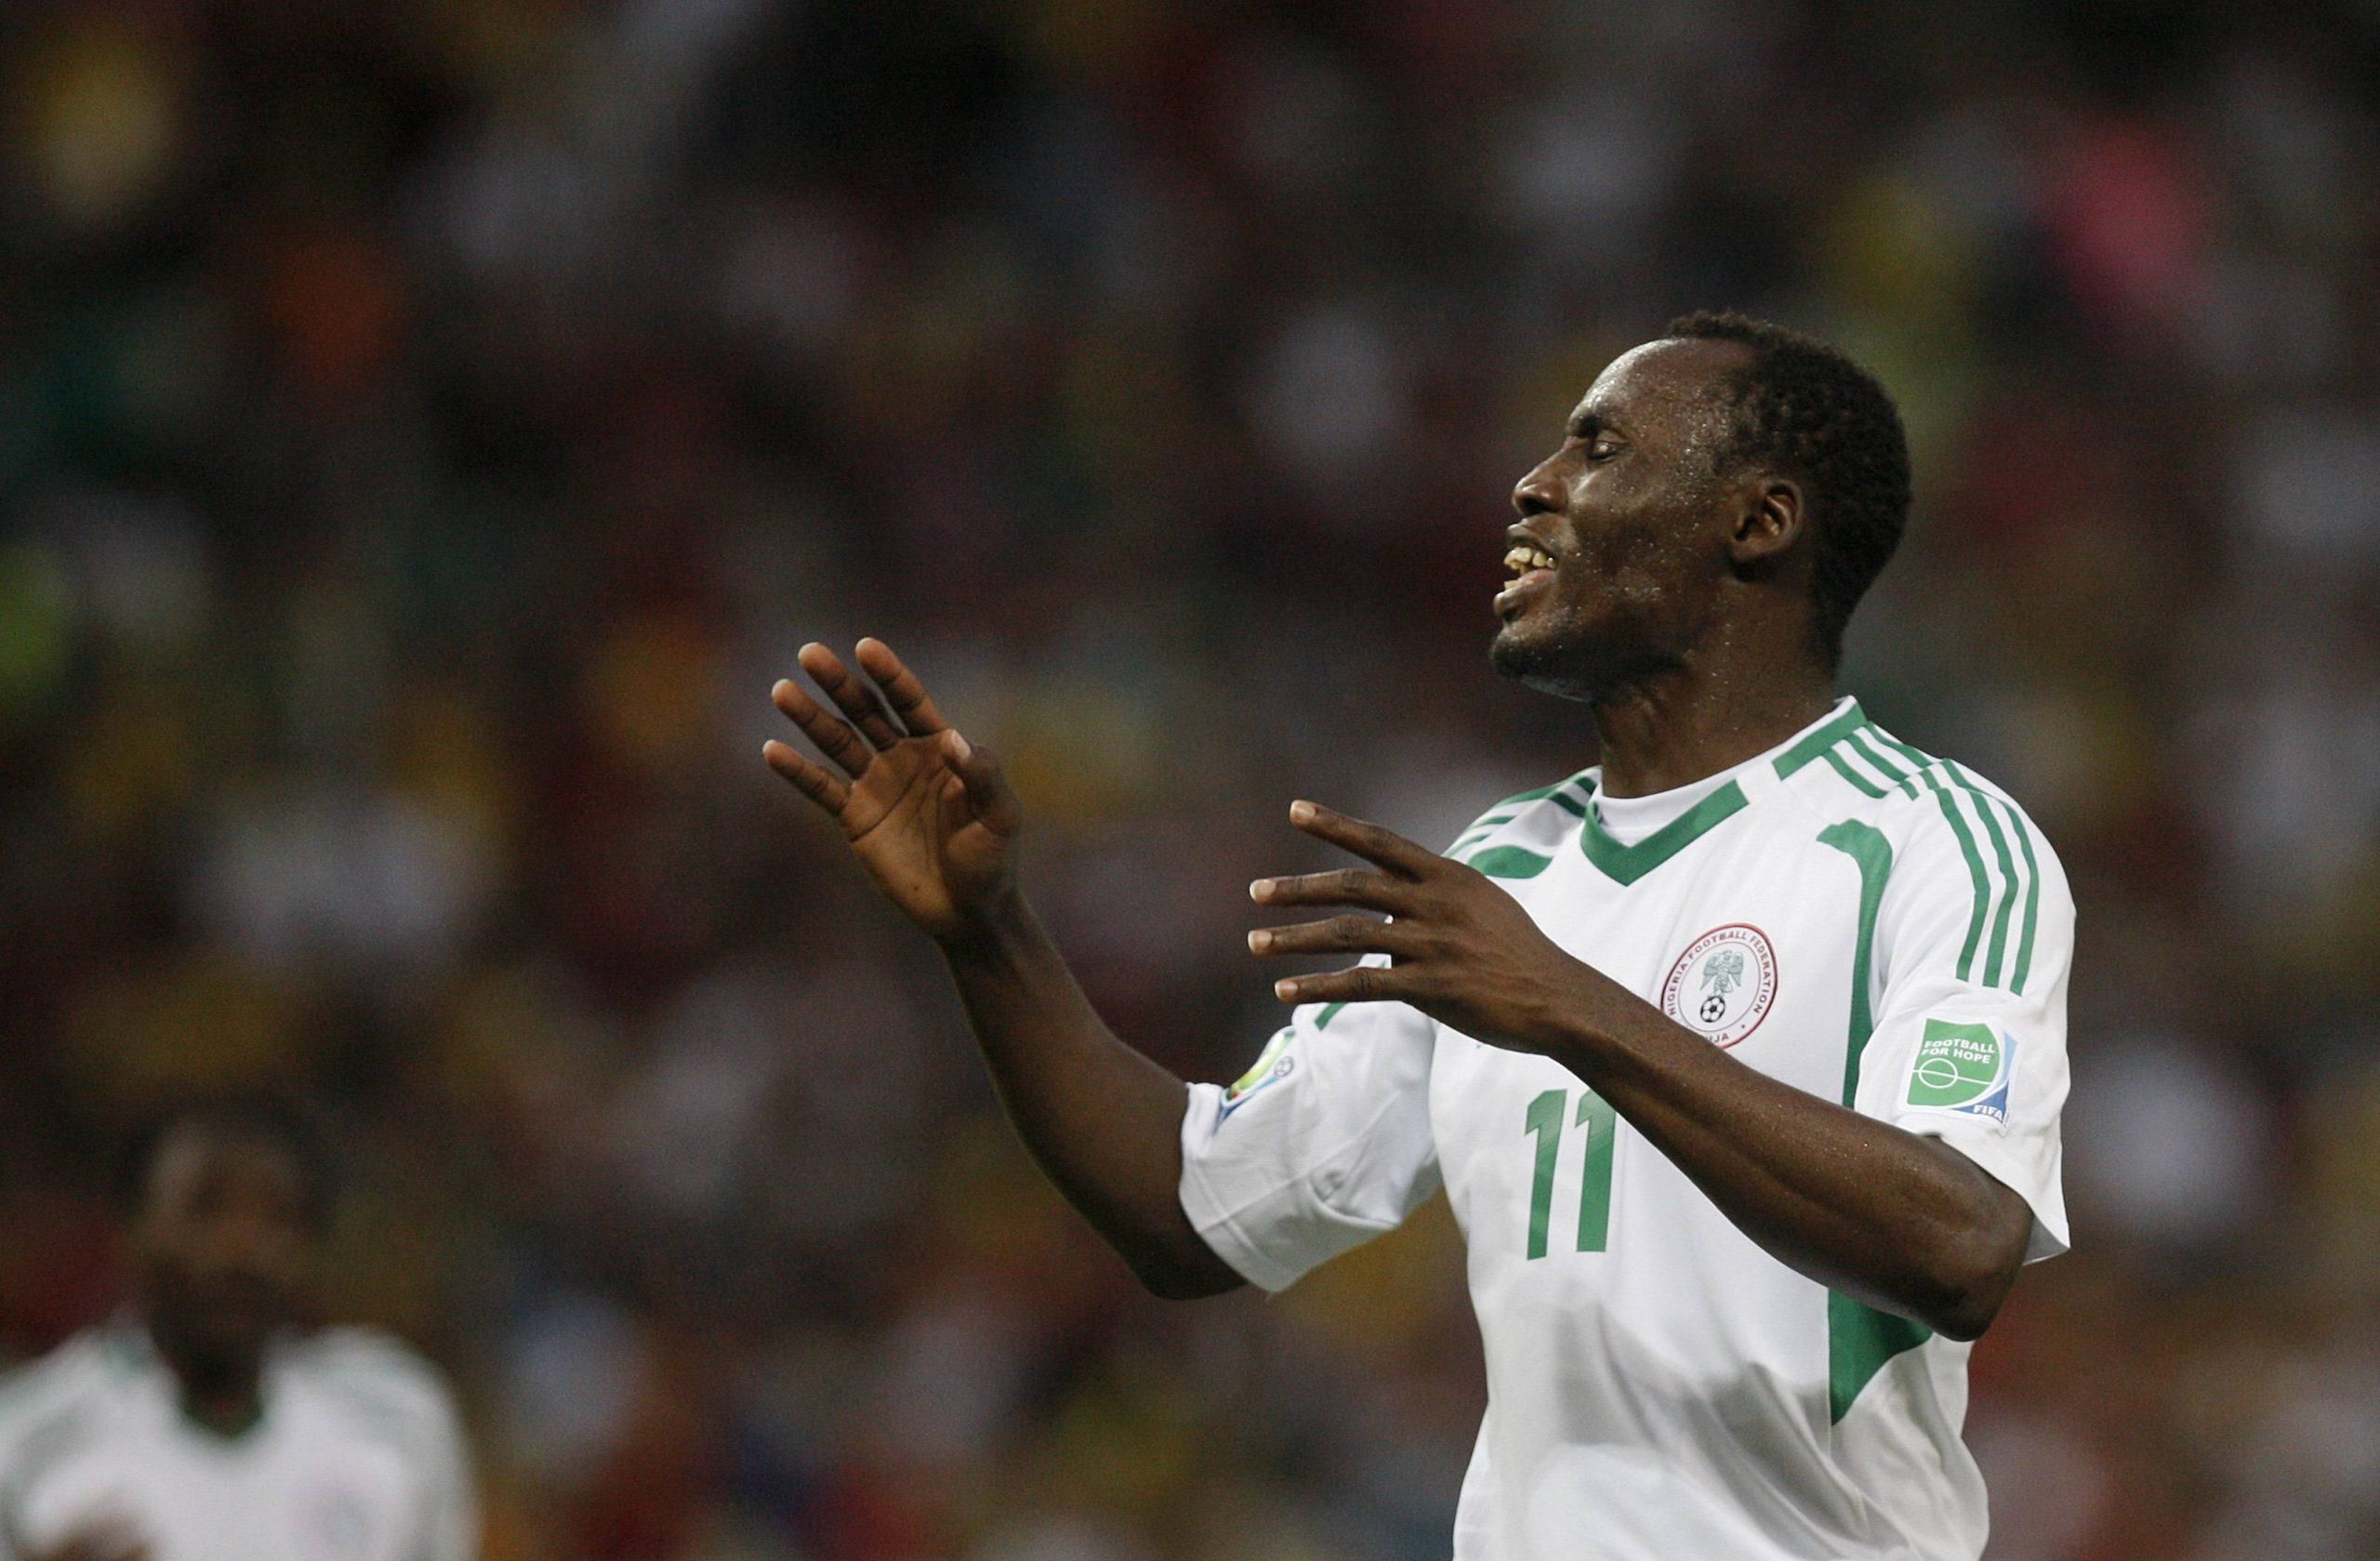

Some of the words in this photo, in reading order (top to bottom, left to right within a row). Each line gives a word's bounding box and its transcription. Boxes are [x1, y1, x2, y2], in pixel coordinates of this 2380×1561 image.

[1667, 962, 1688, 1015] NIGERIA
[1687, 931, 1747, 959] FOOTBALL
[1749, 935, 1771, 1013] FEDERATION
[1924, 1038, 1995, 1053] FOOTBALL
[1921, 1047, 1950, 1056] FOR
[1953, 1048, 1991, 1064] HOPE
[1973, 1105, 2003, 1122] FIFA
[1525, 1089, 1616, 1261] 11
